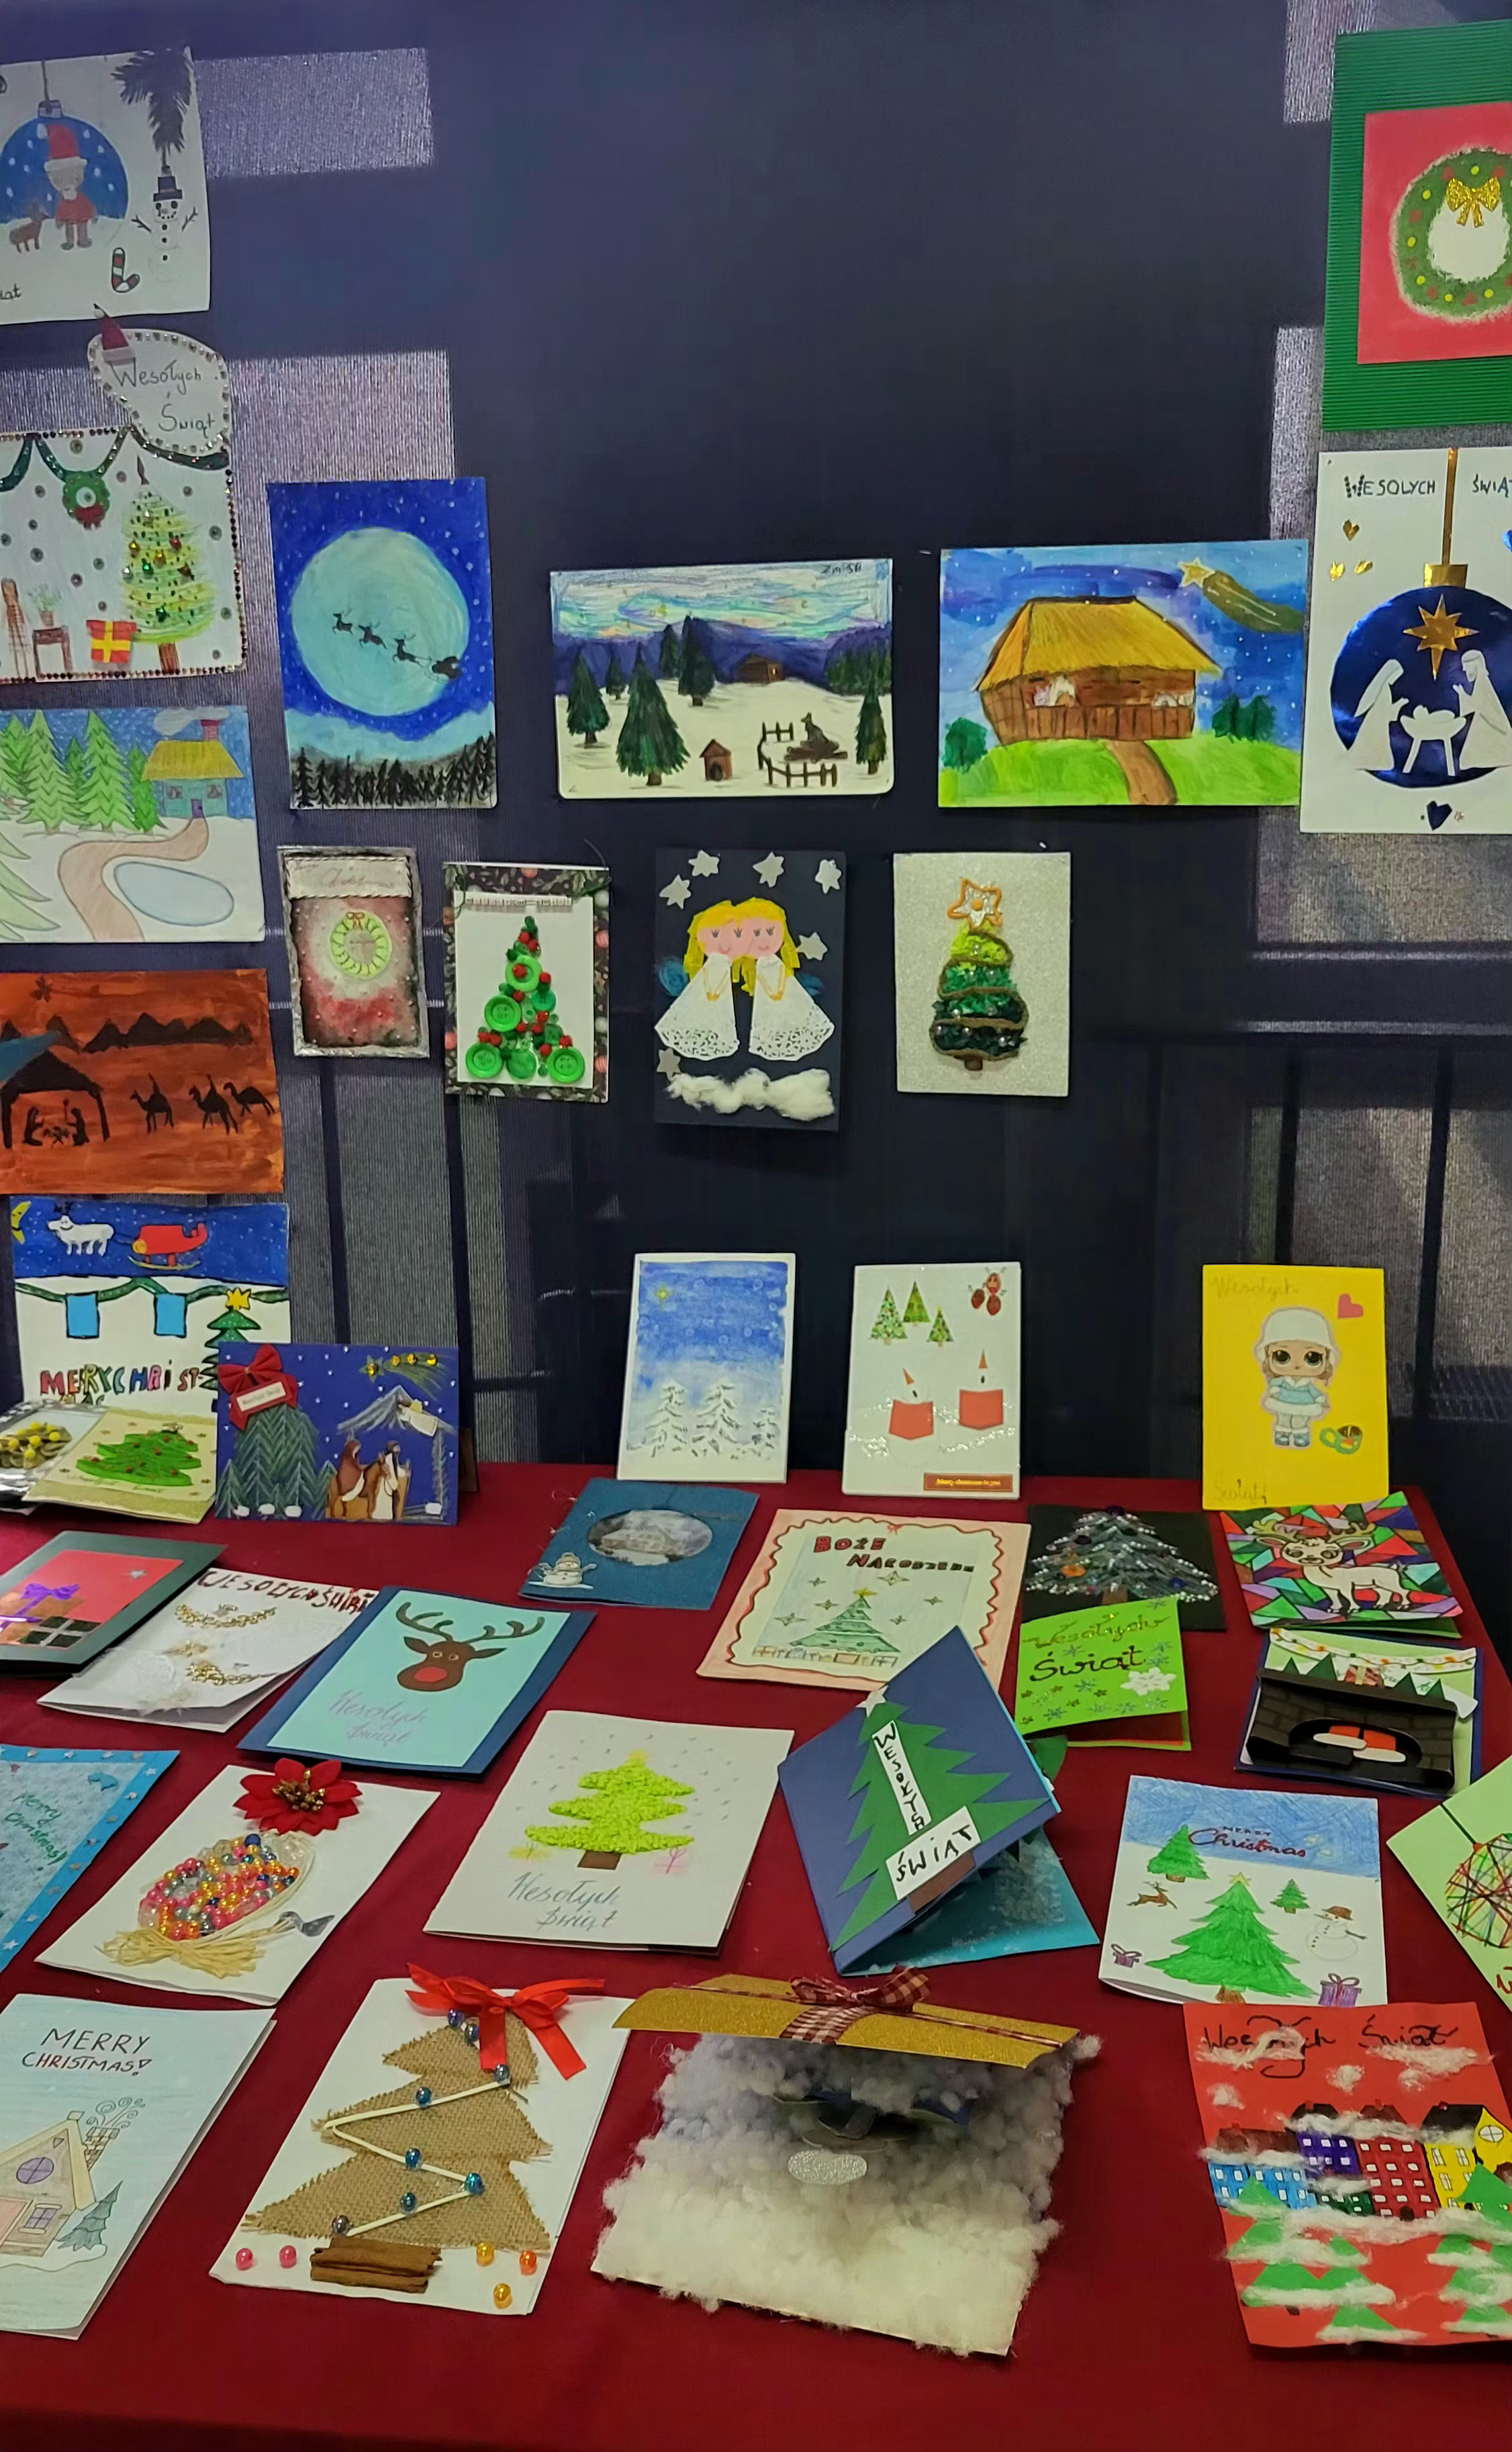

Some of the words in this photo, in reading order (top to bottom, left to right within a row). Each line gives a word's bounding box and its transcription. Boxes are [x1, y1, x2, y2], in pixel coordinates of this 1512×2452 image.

[108, 359, 201, 395] Wesołych
[158, 392, 216, 438] Świąt
[1187, 1828, 1307, 1858] Christmas
[40, 2028, 151, 2055] MERRY
[22, 2051, 153, 2077] CHRISTMAS!
